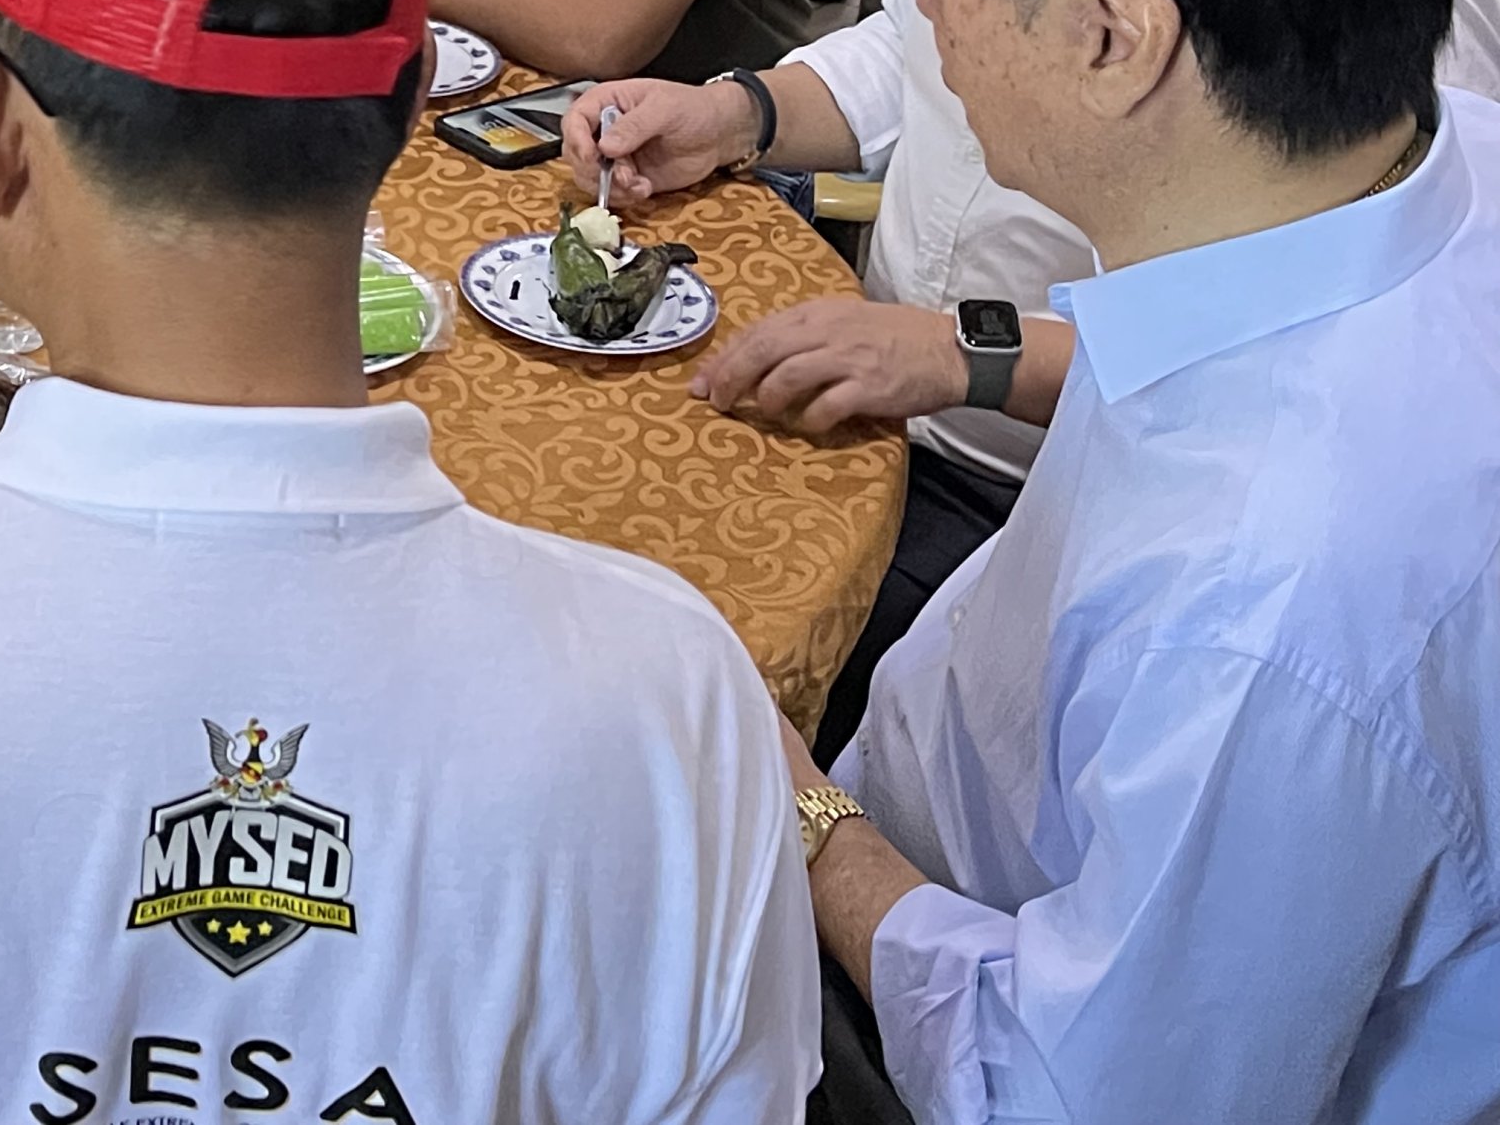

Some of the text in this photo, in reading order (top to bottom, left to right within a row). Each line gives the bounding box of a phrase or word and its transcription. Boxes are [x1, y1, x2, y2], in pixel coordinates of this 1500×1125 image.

[141, 809, 352, 899] MYSED
[140, 892, 347, 922] EXTREME GAME CHALLENGE
